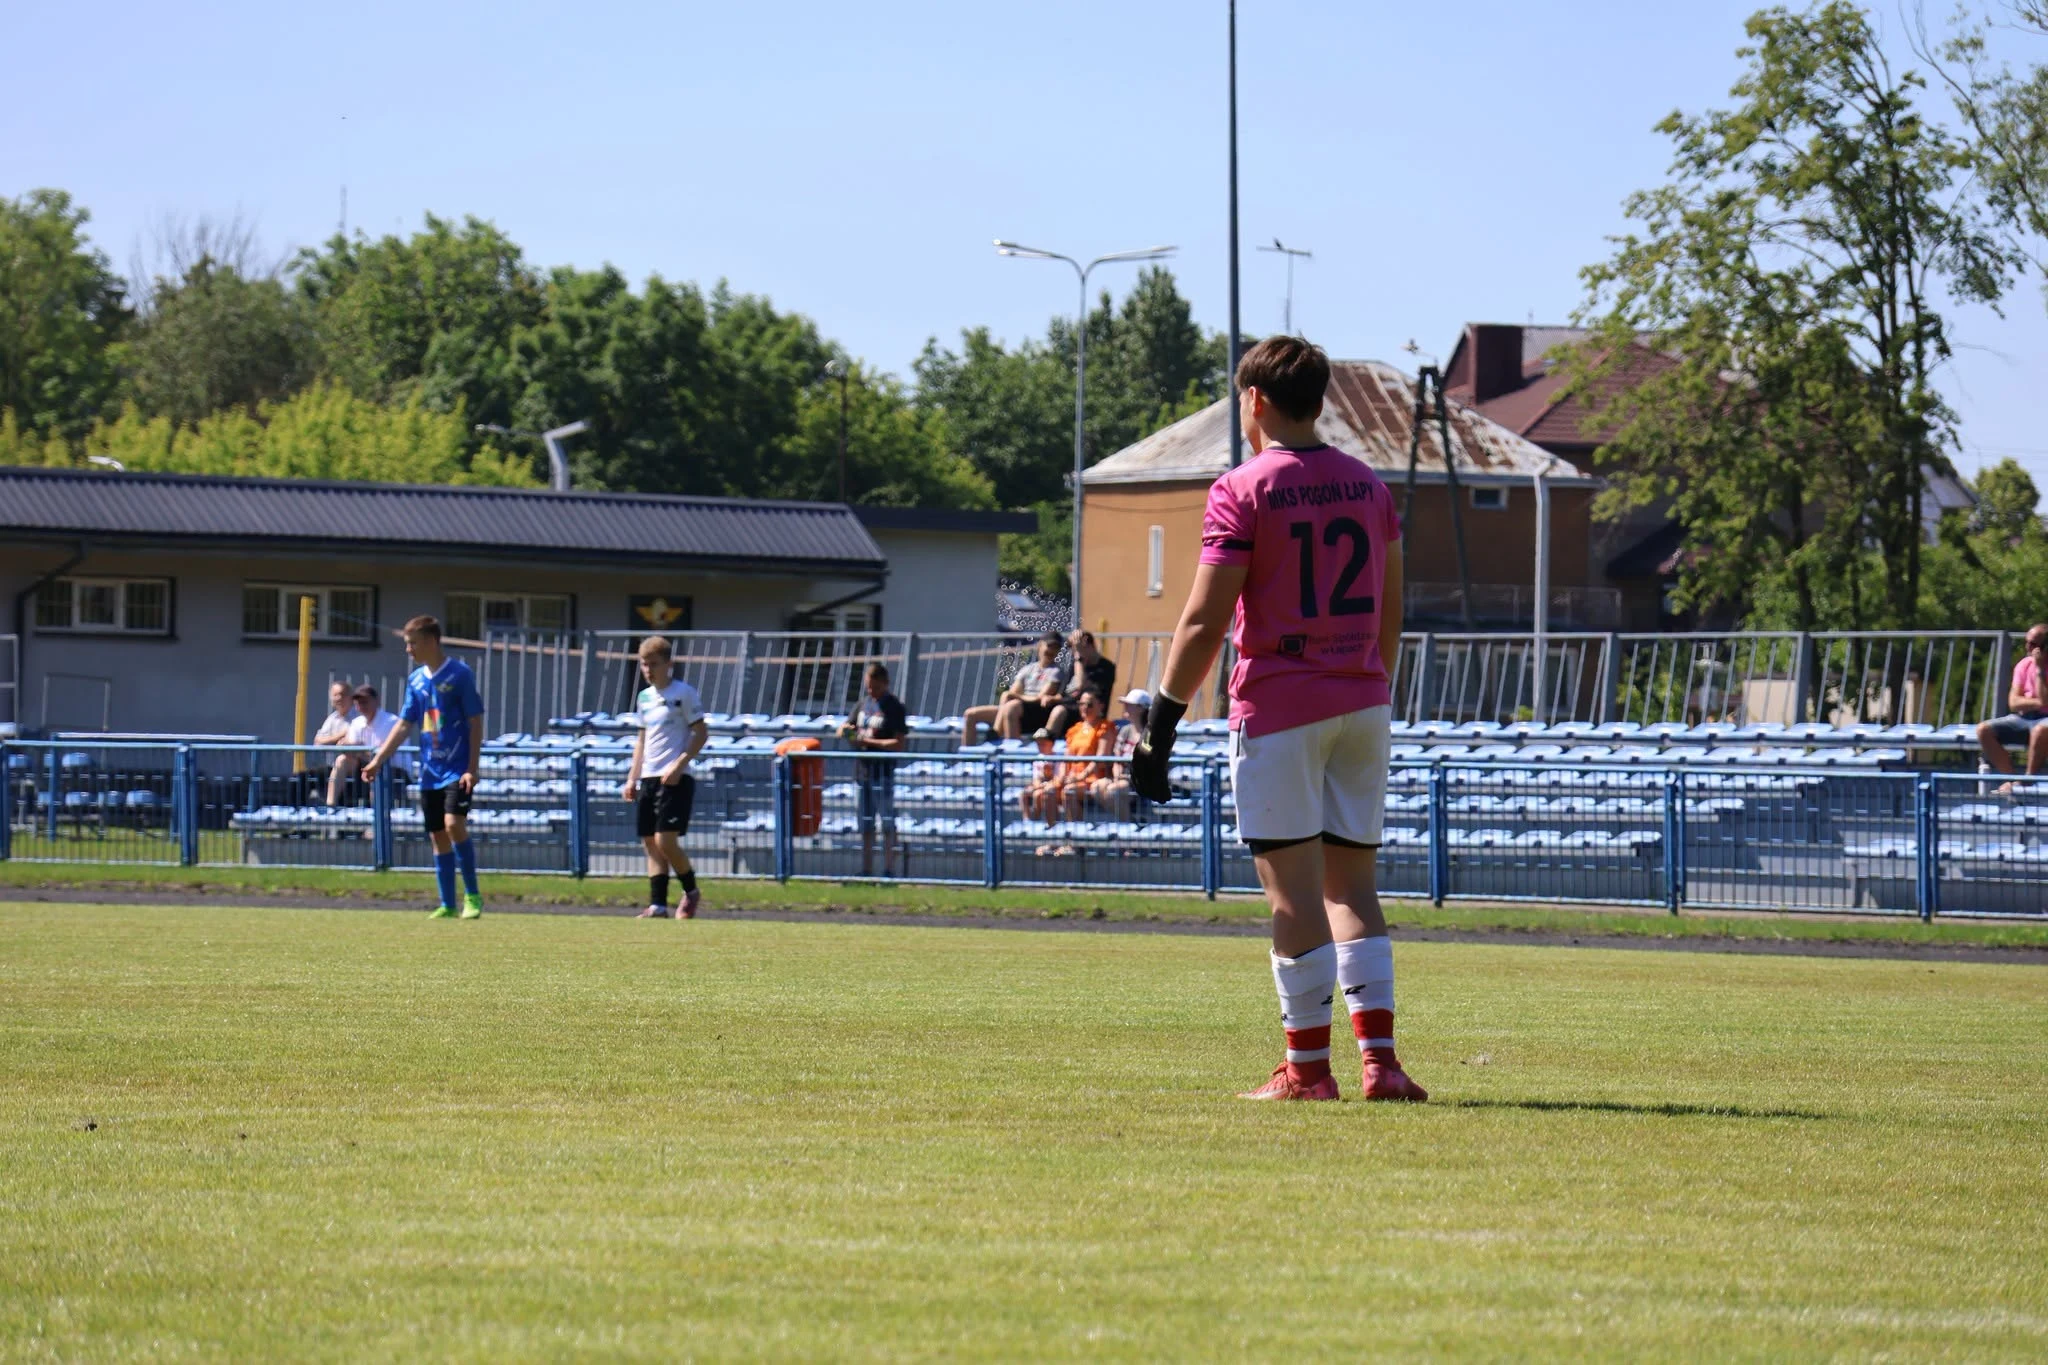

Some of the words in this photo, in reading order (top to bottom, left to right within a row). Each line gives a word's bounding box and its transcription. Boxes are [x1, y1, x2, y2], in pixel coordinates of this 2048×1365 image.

[1268, 487, 1298, 510] MKS
[1300, 478, 1342, 506] POGOŃ
[1345, 481, 1374, 502] ŁAPY
[1290, 517, 1375, 618] 12
